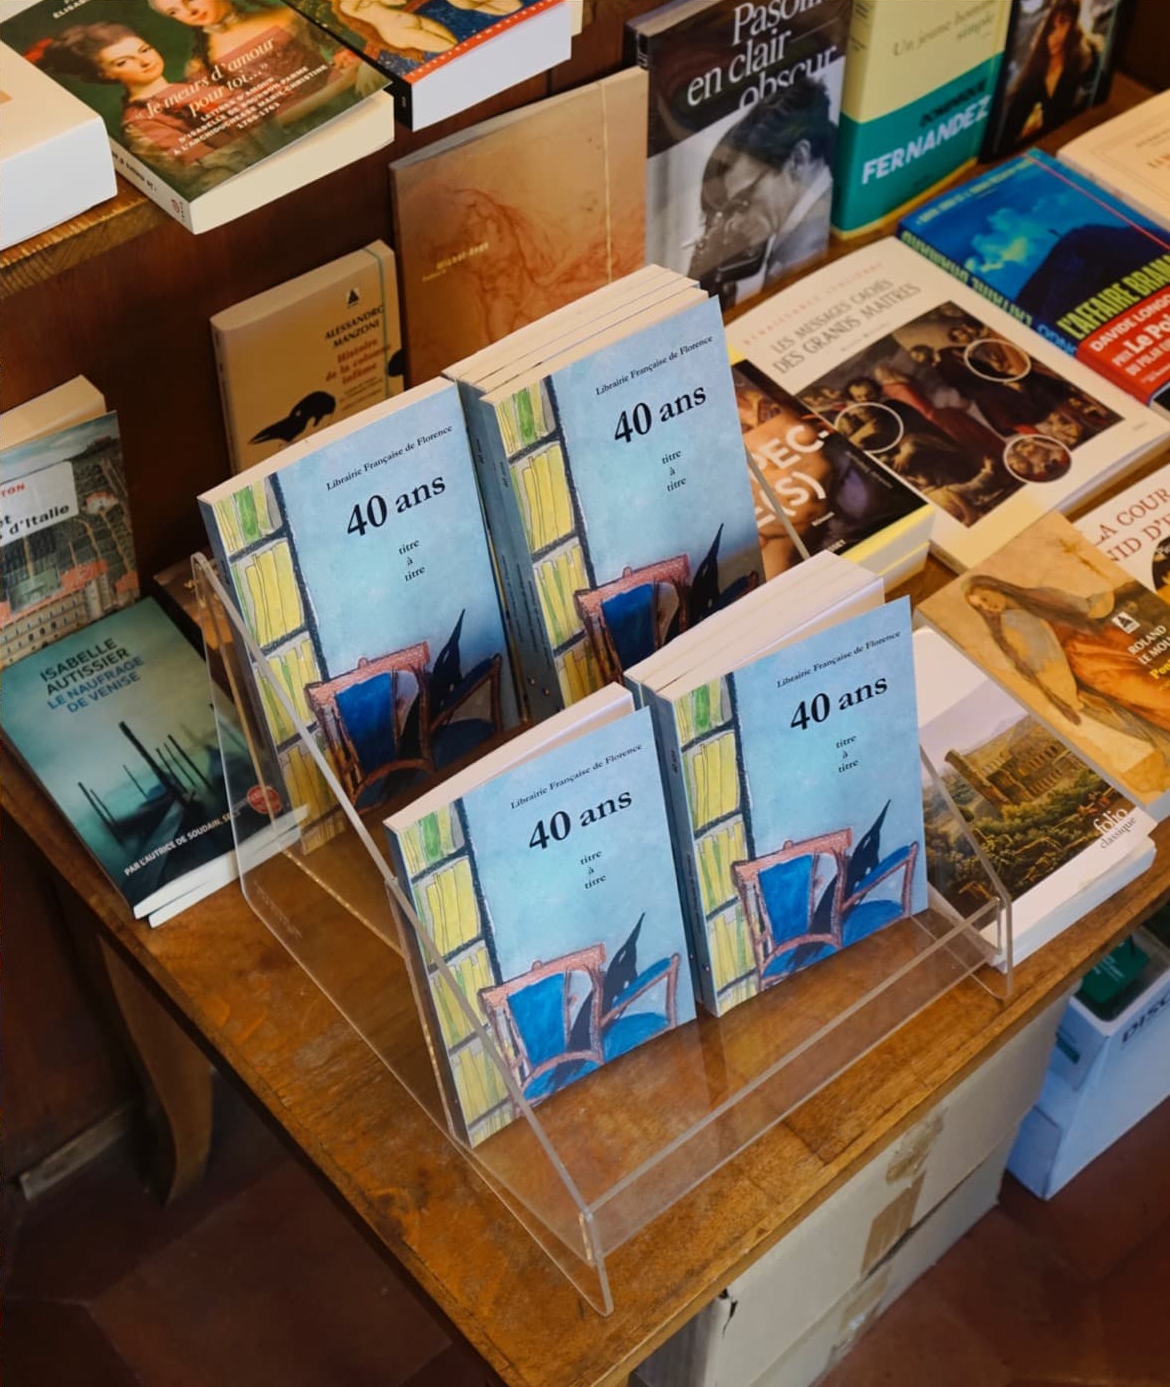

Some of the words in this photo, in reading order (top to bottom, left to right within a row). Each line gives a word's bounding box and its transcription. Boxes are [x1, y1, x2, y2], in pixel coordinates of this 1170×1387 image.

[161, 74, 211, 109] meurs
[209, 36, 278, 82] d'amour
[687, 66, 722, 106] en
[728, 28, 791, 83] clair
[739, 45, 837, 110] obscur
[861, 95, 991, 185] FERNANDEZ
[1057, 283, 1140, 340] L'AFFAIRE
[595, 375, 629, 396] Librairie
[630, 357, 667, 378] Française
[680, 336, 713, 355] Florence
[614, 402, 652, 443] 40
[659, 386, 706, 422] ans
[326, 468, 362, 491] Librairie
[363, 449, 403, 472] Française
[417, 425, 452, 446] Florence
[662, 450, 681, 464] titre
[346, 494, 388, 537] 40
[395, 476, 446, 514] ans
[666, 478, 687, 492] titre
[398, 539, 420, 555] titre
[404, 566, 425, 581] titre
[40, 638, 118, 682] ISABELLE
[46, 648, 130, 695] AUTISSIER
[69, 657, 145, 701] NAUFRAGE
[776, 668, 811, 688] Librairie
[813, 651, 852, 672] Française
[865, 631, 901, 650] Florence
[66, 698, 88, 714] DE
[89, 670, 141, 706] VENISE
[790, 693, 830, 730] 40
[838, 677, 888, 711] ans
[836, 735, 857, 748] titre
[838, 760, 859, 773] titre
[510, 788, 548, 809] Librairie
[549, 767, 591, 790] Française
[605, 745, 642, 764] Florence
[529, 810, 571, 849] 40
[580, 791, 632, 827] ans
[1092, 805, 1129, 838] folio
[580, 851, 602, 865] titre
[584, 874, 607, 890] titre
